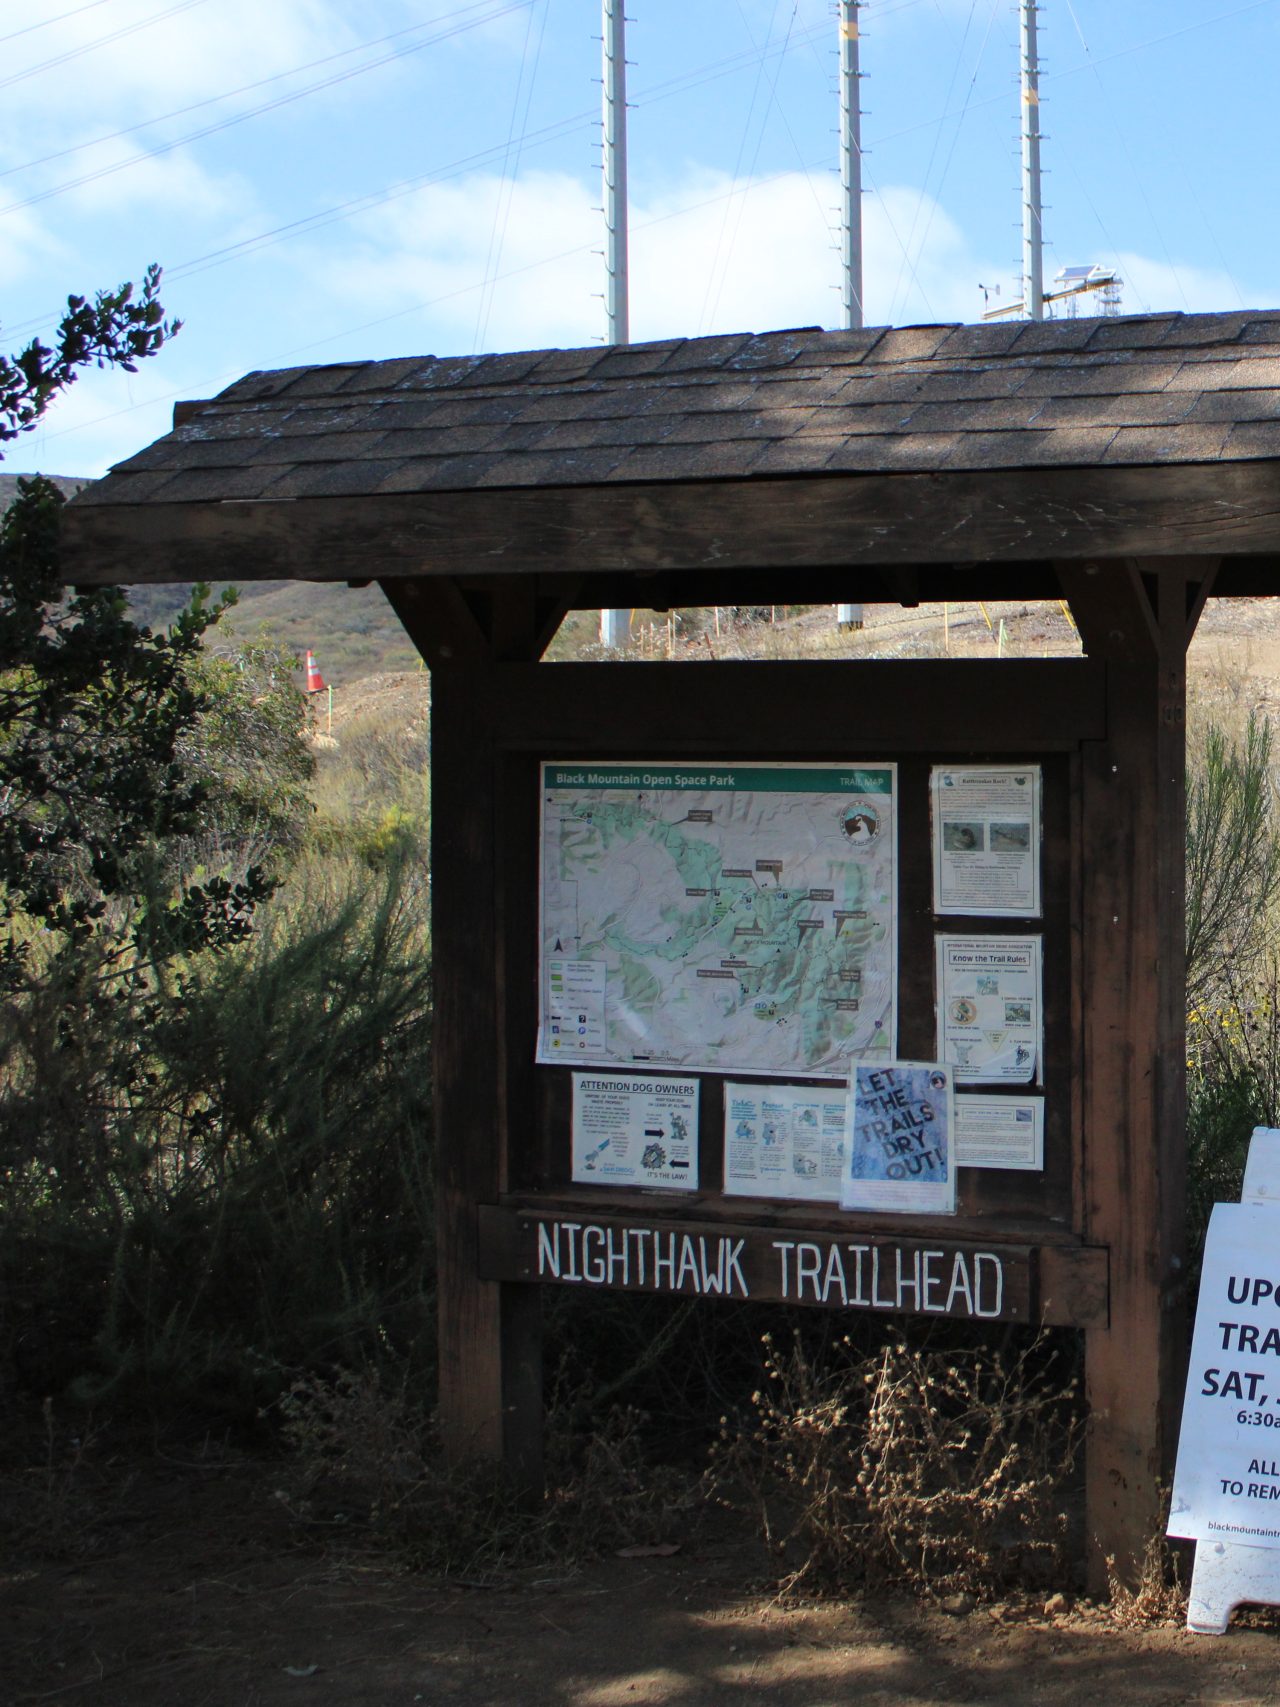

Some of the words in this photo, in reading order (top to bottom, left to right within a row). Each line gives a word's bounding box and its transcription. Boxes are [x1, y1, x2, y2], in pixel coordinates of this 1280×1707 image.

[556, 773, 585, 784] Black
[588, 773, 640, 785] Mountain
[643, 774, 672, 787] Open
[675, 774, 707, 787] Space
[709, 775, 735, 786] Park
[840, 777, 863, 786] TRAIL
[864, 777, 884, 786] MAP
[952, 954, 973, 962] Know
[989, 955, 1006, 963] Trail
[1006, 955, 1027, 963] Rules
[580, 1080, 630, 1091] ATTENTION
[632, 1083, 653, 1092] DOG
[655, 1084, 695, 1095] OWNERS
[860, 1068, 895, 1096] LET
[864, 1088, 909, 1116] THE
[860, 1101, 935, 1142] TRAILS
[882, 1129, 925, 1159] DRY
[887, 1148, 945, 1179] OUT!
[537, 1222, 749, 1298] NIGHTHAWK
[772, 1241, 1003, 1318] TRAILHEAD
[1201, 1368, 1268, 1406] SAT,
[1248, 1459, 1280, 1477] ALL
[1220, 1479, 1244, 1495] TO
